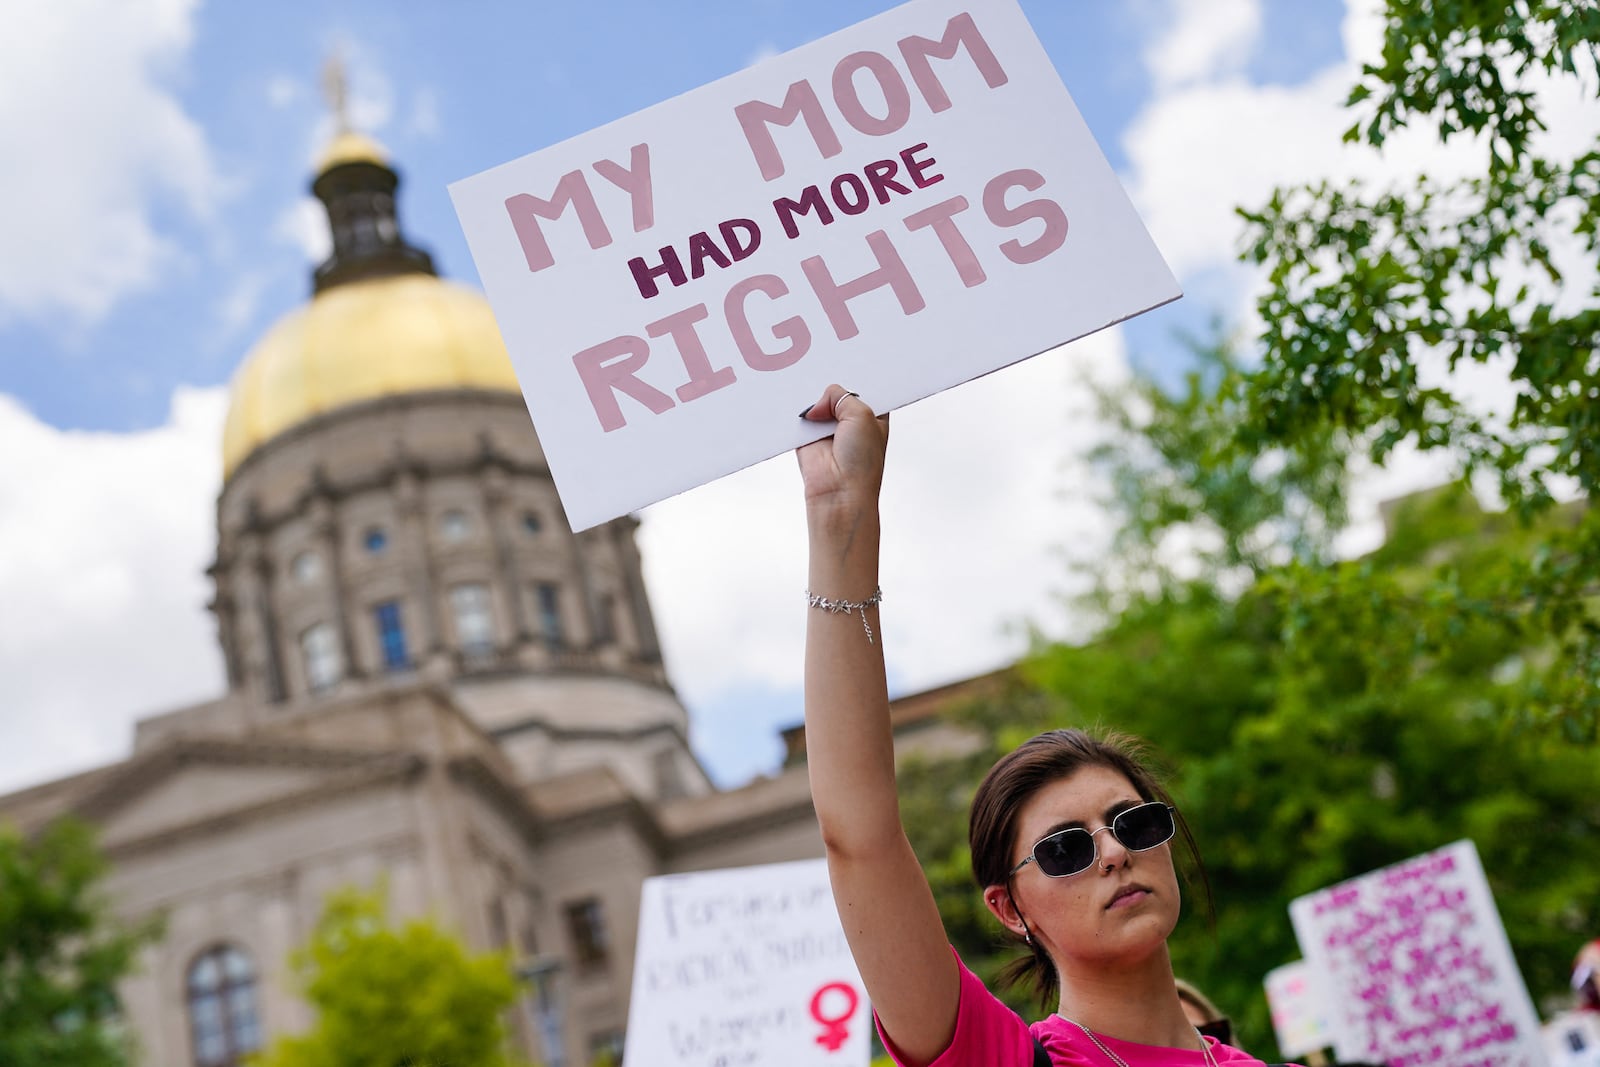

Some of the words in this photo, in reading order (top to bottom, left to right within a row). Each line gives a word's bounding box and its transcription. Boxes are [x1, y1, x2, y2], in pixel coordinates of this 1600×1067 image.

[505, 143, 653, 272] MY
[735, 12, 1008, 181] MOM
[627, 218, 761, 299] HAD
[772, 142, 944, 239] MORE
[573, 168, 1068, 432] RIGHTS
